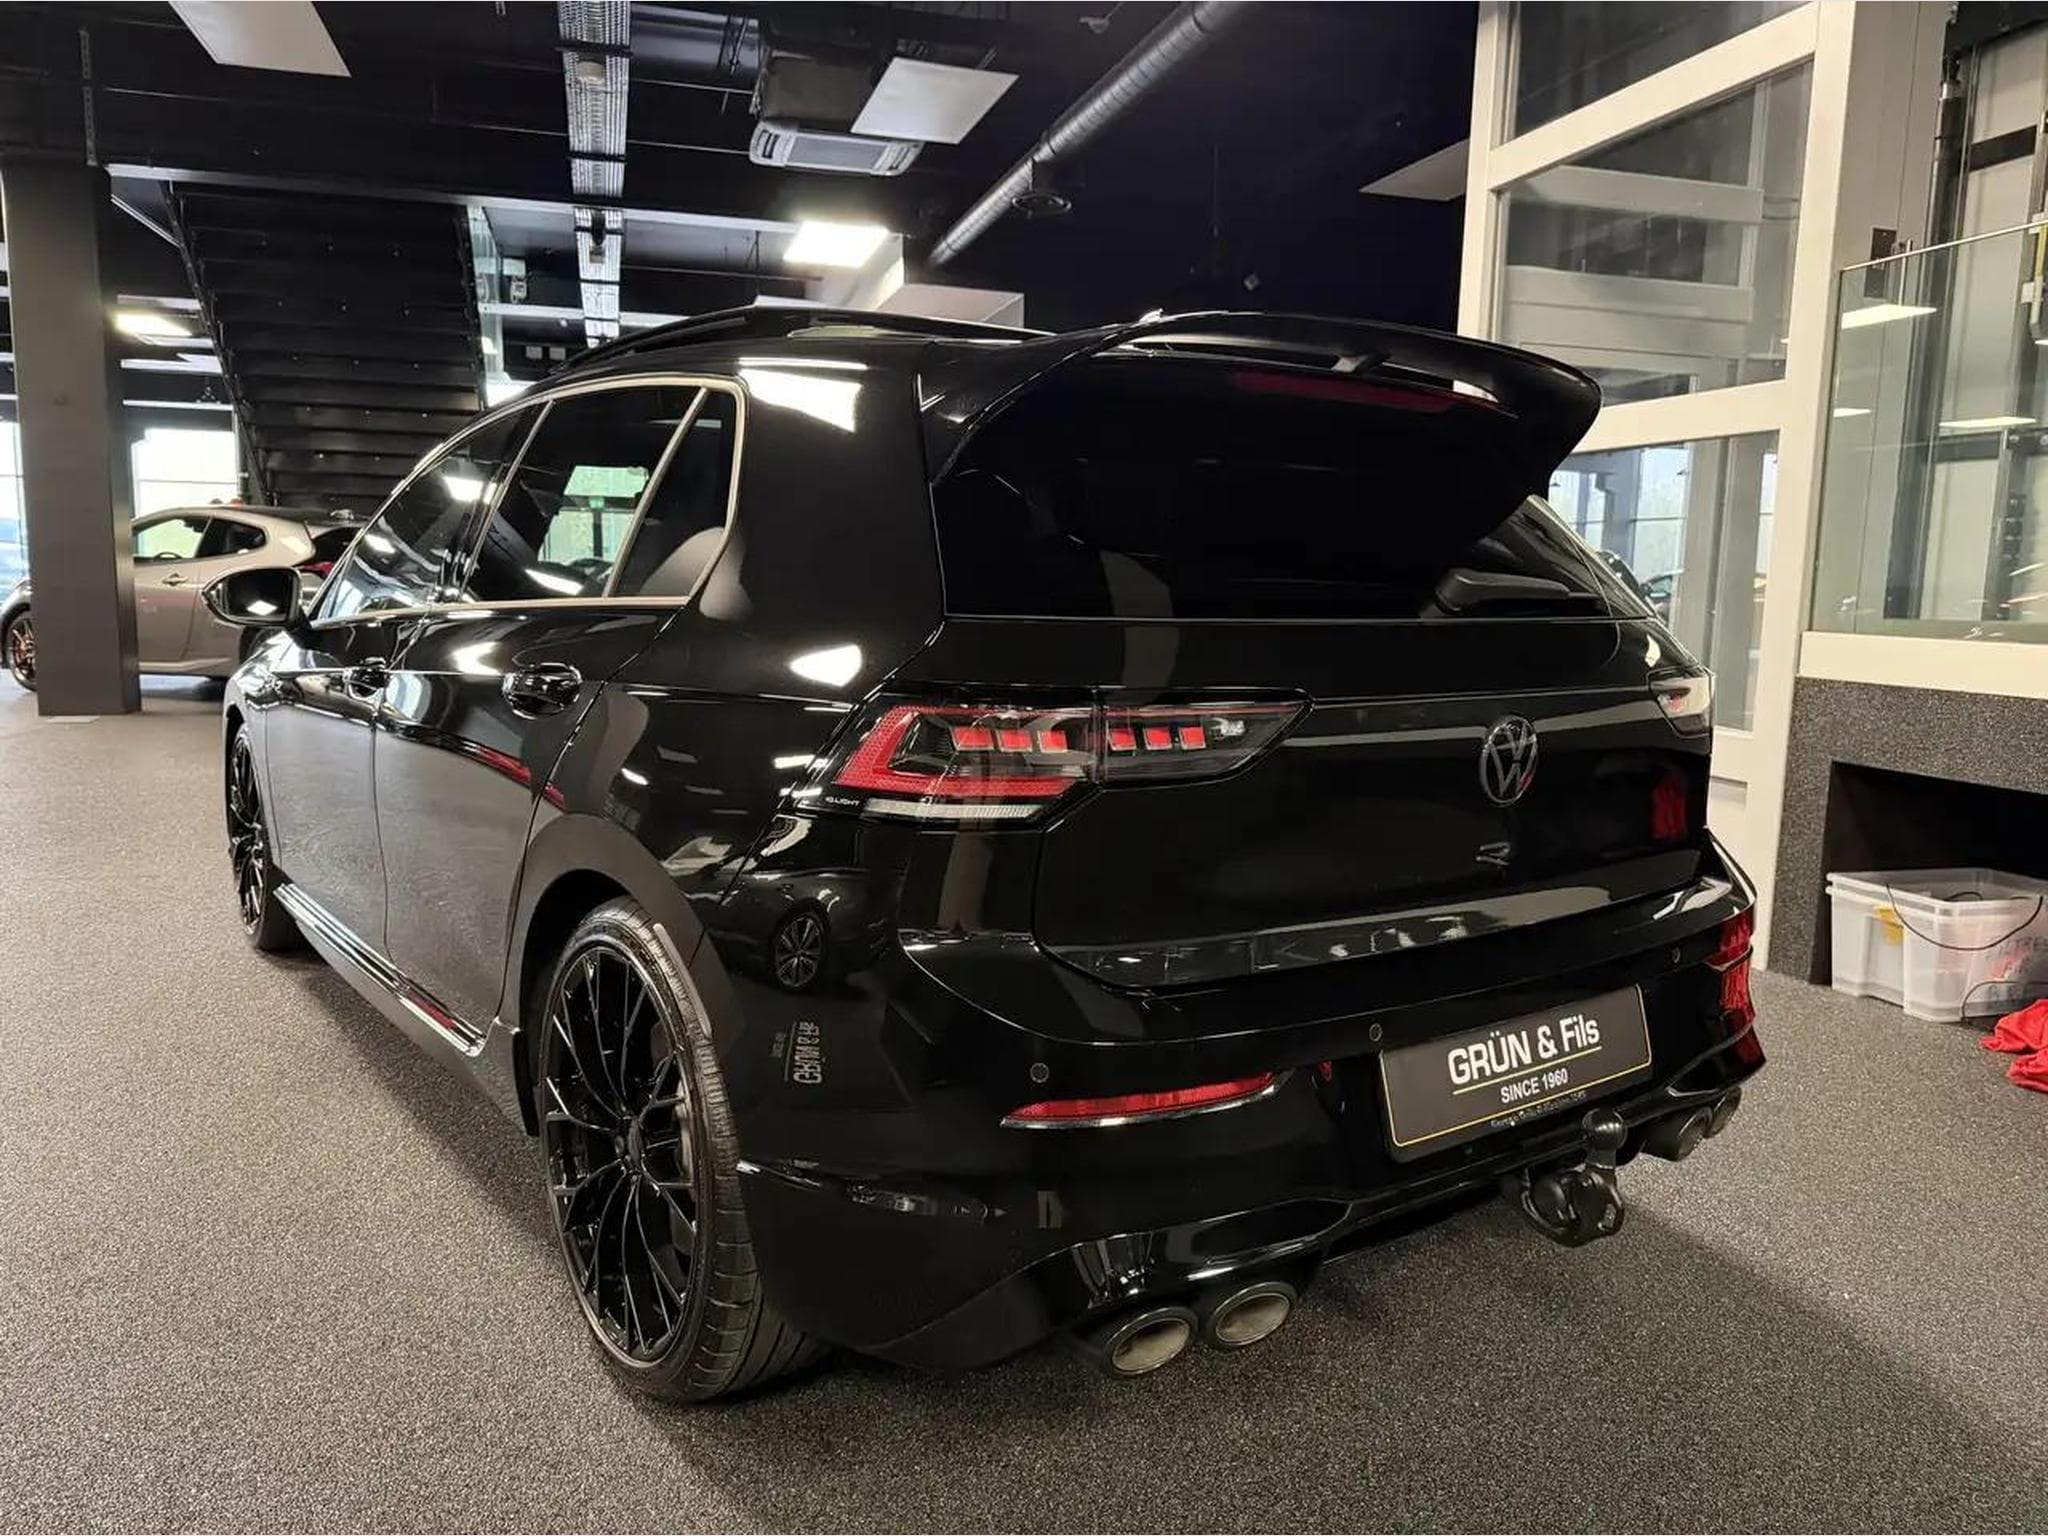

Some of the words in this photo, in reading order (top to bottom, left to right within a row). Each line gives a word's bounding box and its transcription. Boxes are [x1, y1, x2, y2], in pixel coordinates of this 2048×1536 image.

[1448, 1031, 1532, 1085] GRÜN
[1537, 1026, 1559, 1059] &
[1559, 1014, 1600, 1052] Fils
[1501, 1077, 1540, 1104] SINCE
[1541, 1067, 1569, 1092] 1960
